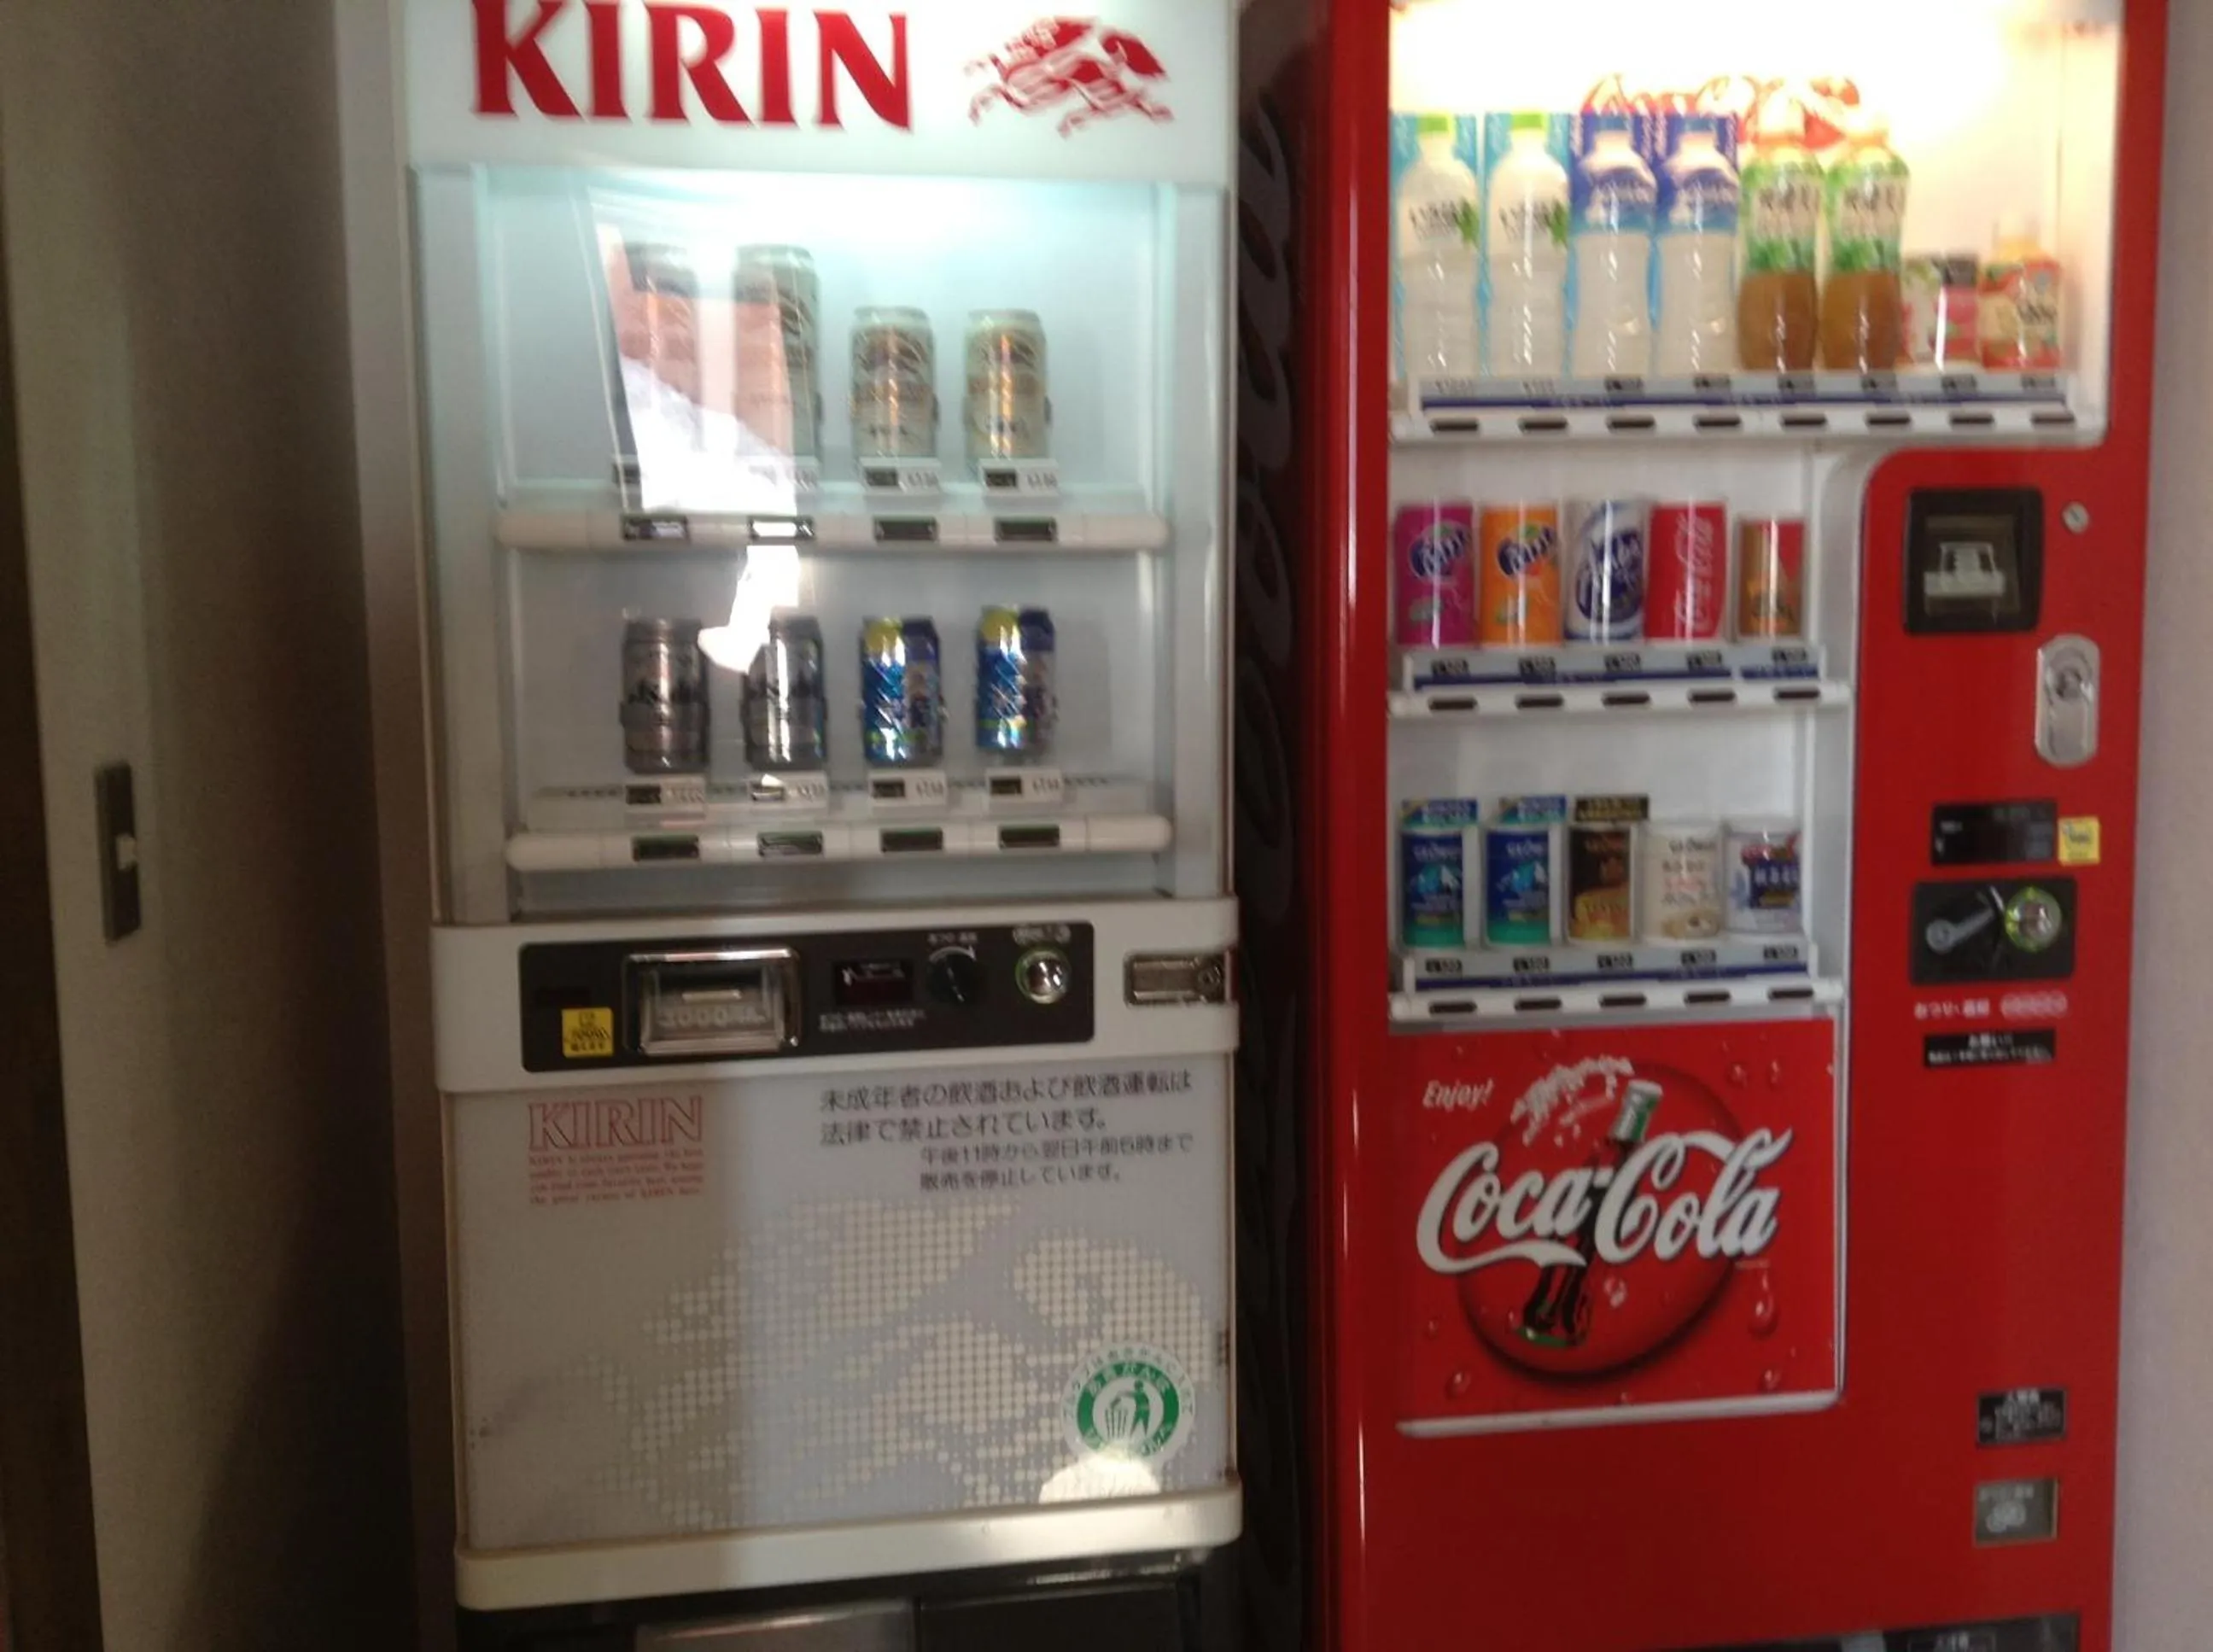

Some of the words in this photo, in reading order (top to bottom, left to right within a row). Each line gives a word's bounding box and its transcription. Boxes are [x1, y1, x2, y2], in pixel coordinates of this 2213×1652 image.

[472, 0, 913, 134] KIRIN
[820, 1069, 1193, 1112] 未成年者の飲酒および飲酒運転は
[1422, 1077, 1494, 1111] Enjoy!
[528, 1095, 702, 1151] KIRIN
[820, 1107, 1106, 1146] 法律で禁止されています。
[1416, 1128, 1792, 1273] Coca-Cola
